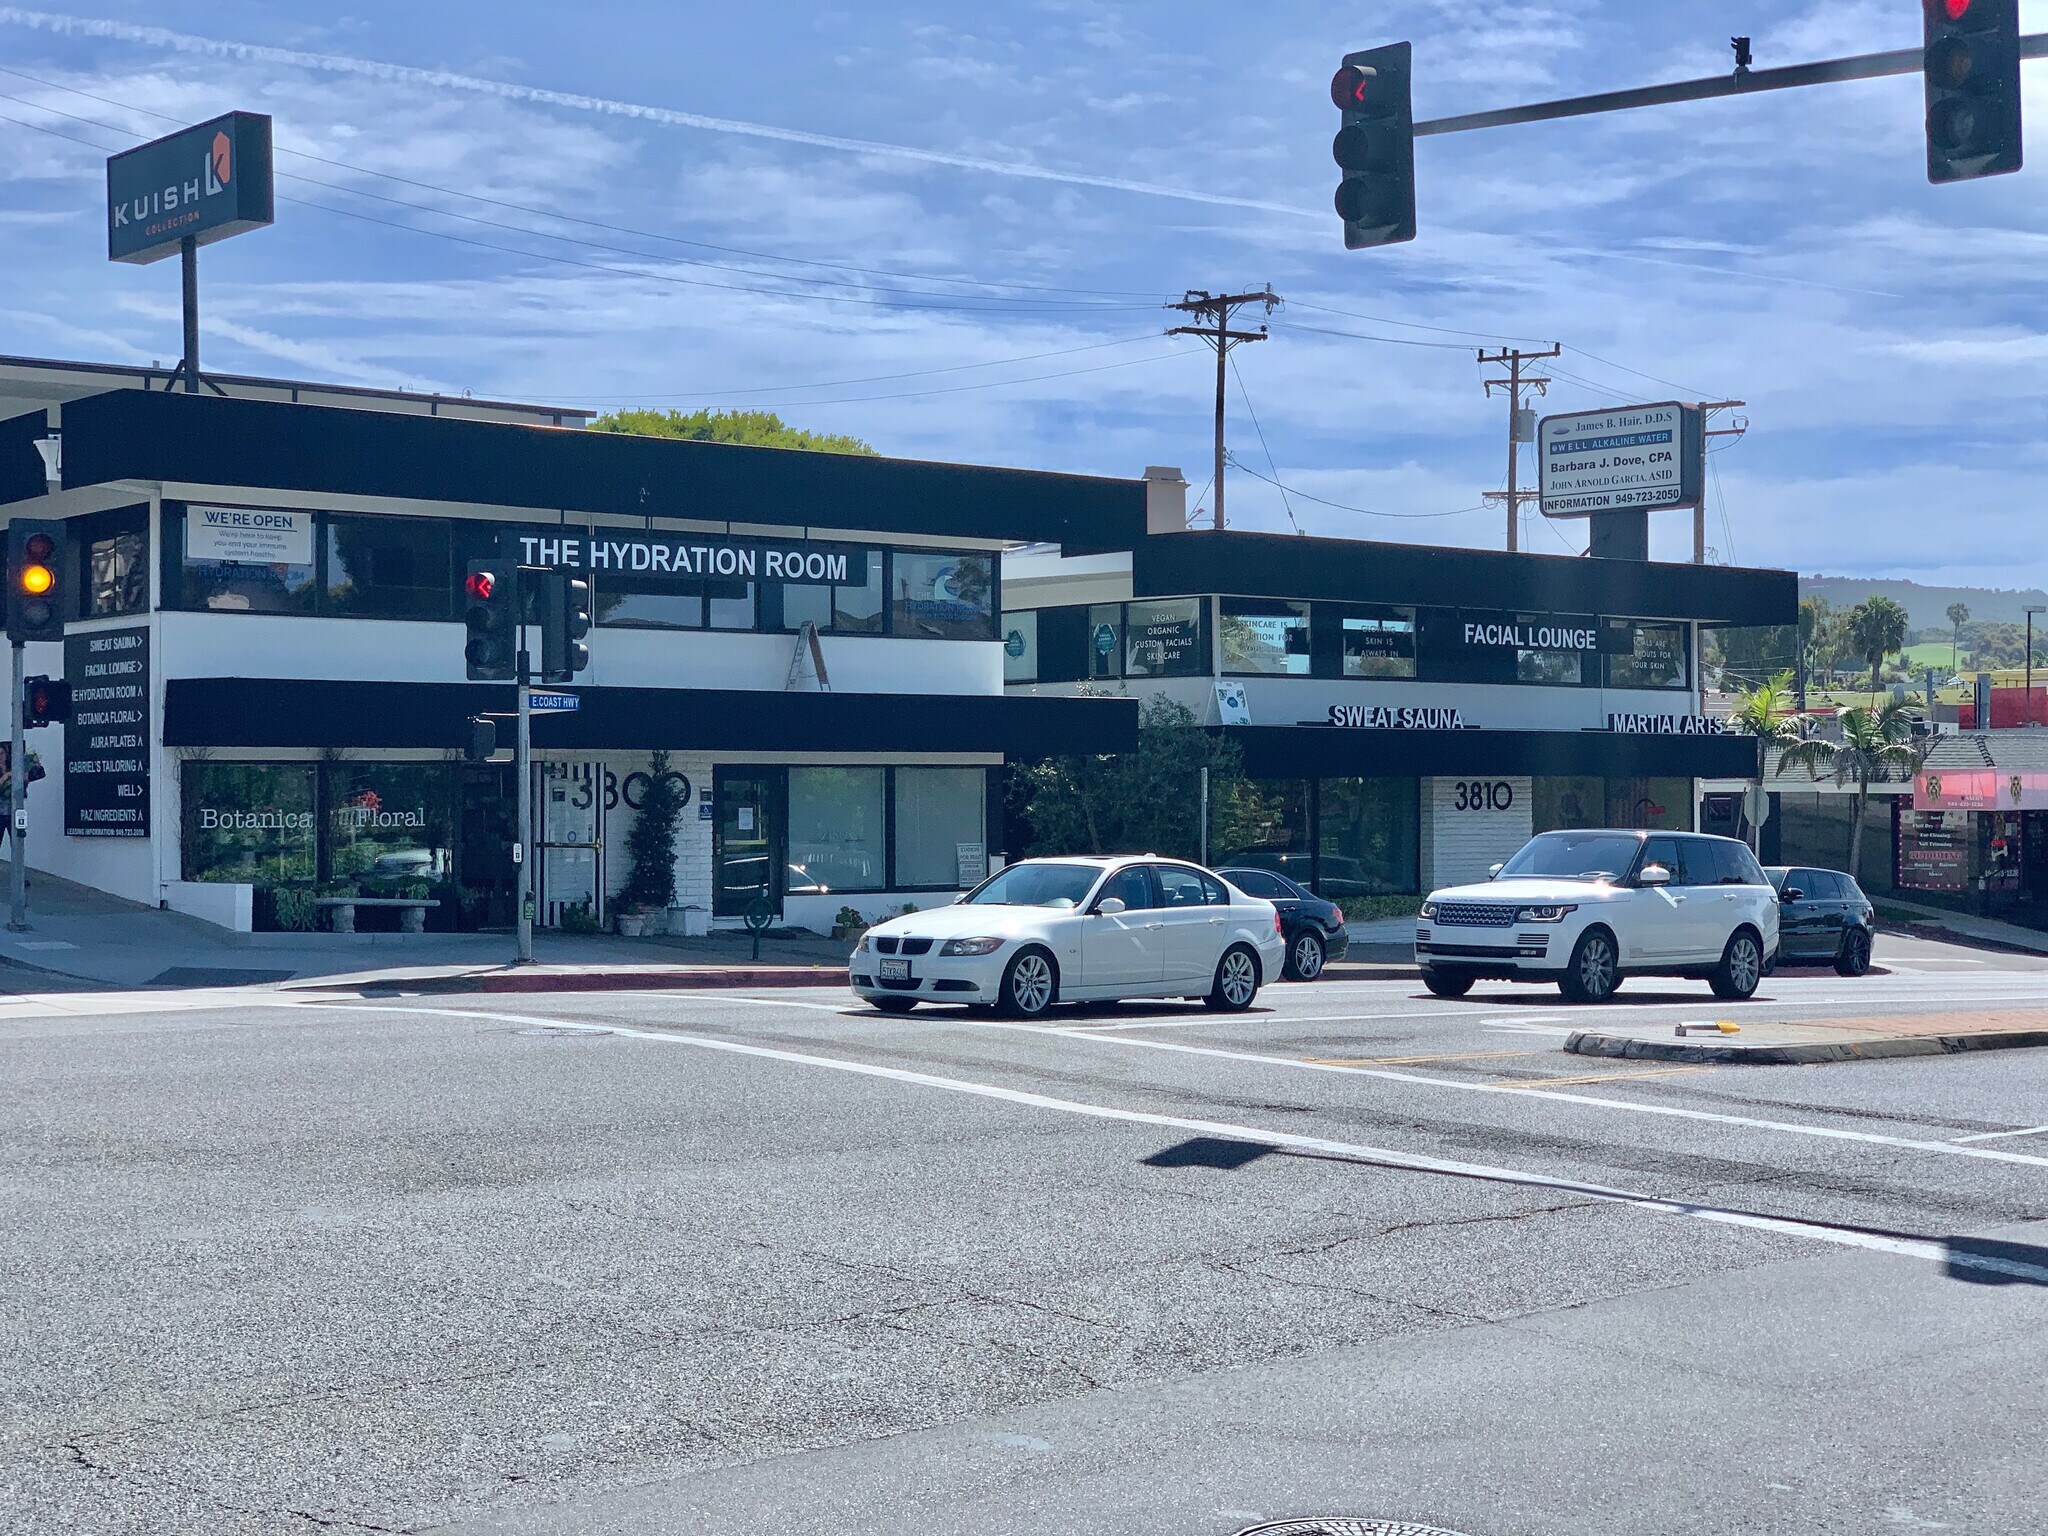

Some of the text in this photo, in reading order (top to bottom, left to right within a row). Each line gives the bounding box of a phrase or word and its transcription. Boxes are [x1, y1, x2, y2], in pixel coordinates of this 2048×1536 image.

[114, 178, 199, 228] KUISH
[145, 210, 200, 236] COLLECTION
[1575, 422, 1603, 432] James
[1607, 419, 1616, 428] B.
[1645, 412, 1672, 424] D.D.S
[1558, 433, 1668, 451] WELL ALKALINE WATER
[1551, 452, 1672, 473] Barbara J. Dove, CPA
[1649, 470, 1672, 481] ASID
[1544, 489, 1679, 510] INFORMATION 949-723-2050
[205, 511, 293, 528] WE'RE OPEN
[265, 533, 282, 541] keep
[259, 542, 287, 550] immune
[224, 550, 249, 558] system
[519, 537, 847, 580] THE HYDRATION ROOM
[1152, 613, 1175, 622] VEGAN
[1239, 620, 1288, 629] SKINCARE IS
[1147, 625, 1180, 635] ORGANIC
[1464, 623, 1597, 650] FACIAL LOUNGE
[90, 636, 137, 652] SWEAT SAUNA
[1135, 638, 1193, 649] CUSTOM FACIALS
[1278, 634, 1293, 642] FOR
[1365, 637, 1394, 646] SKIN IS
[1655, 640, 1666, 648] ARE
[1146, 652, 1181, 661] SKINCARE
[1360, 649, 1387, 658] ALWAYS
[1660, 651, 1671, 659] FOR
[85, 661, 136, 677] FACIAL LOUNGE
[1632, 661, 1665, 670] YOUR SKIN
[79, 687, 114, 701] HYDRATION
[116, 685, 136, 698] ROOM
[563, 698, 580, 708] HWY
[78, 710, 136, 725] BOTANICA FLORAL
[1334, 705, 1464, 729] SWEAT SAUNA
[1613, 714, 1724, 735] MARTIAL ARTS
[90, 735, 136, 749] AURA PILATES
[69, 759, 136, 773] GABRIEL'S TAILORING
[117, 784, 136, 797] WELL
[1455, 781, 1513, 811] 3810
[80, 809, 136, 822] PAZ INGREDIENTS
[200, 807, 426, 829] Botanica Floral
